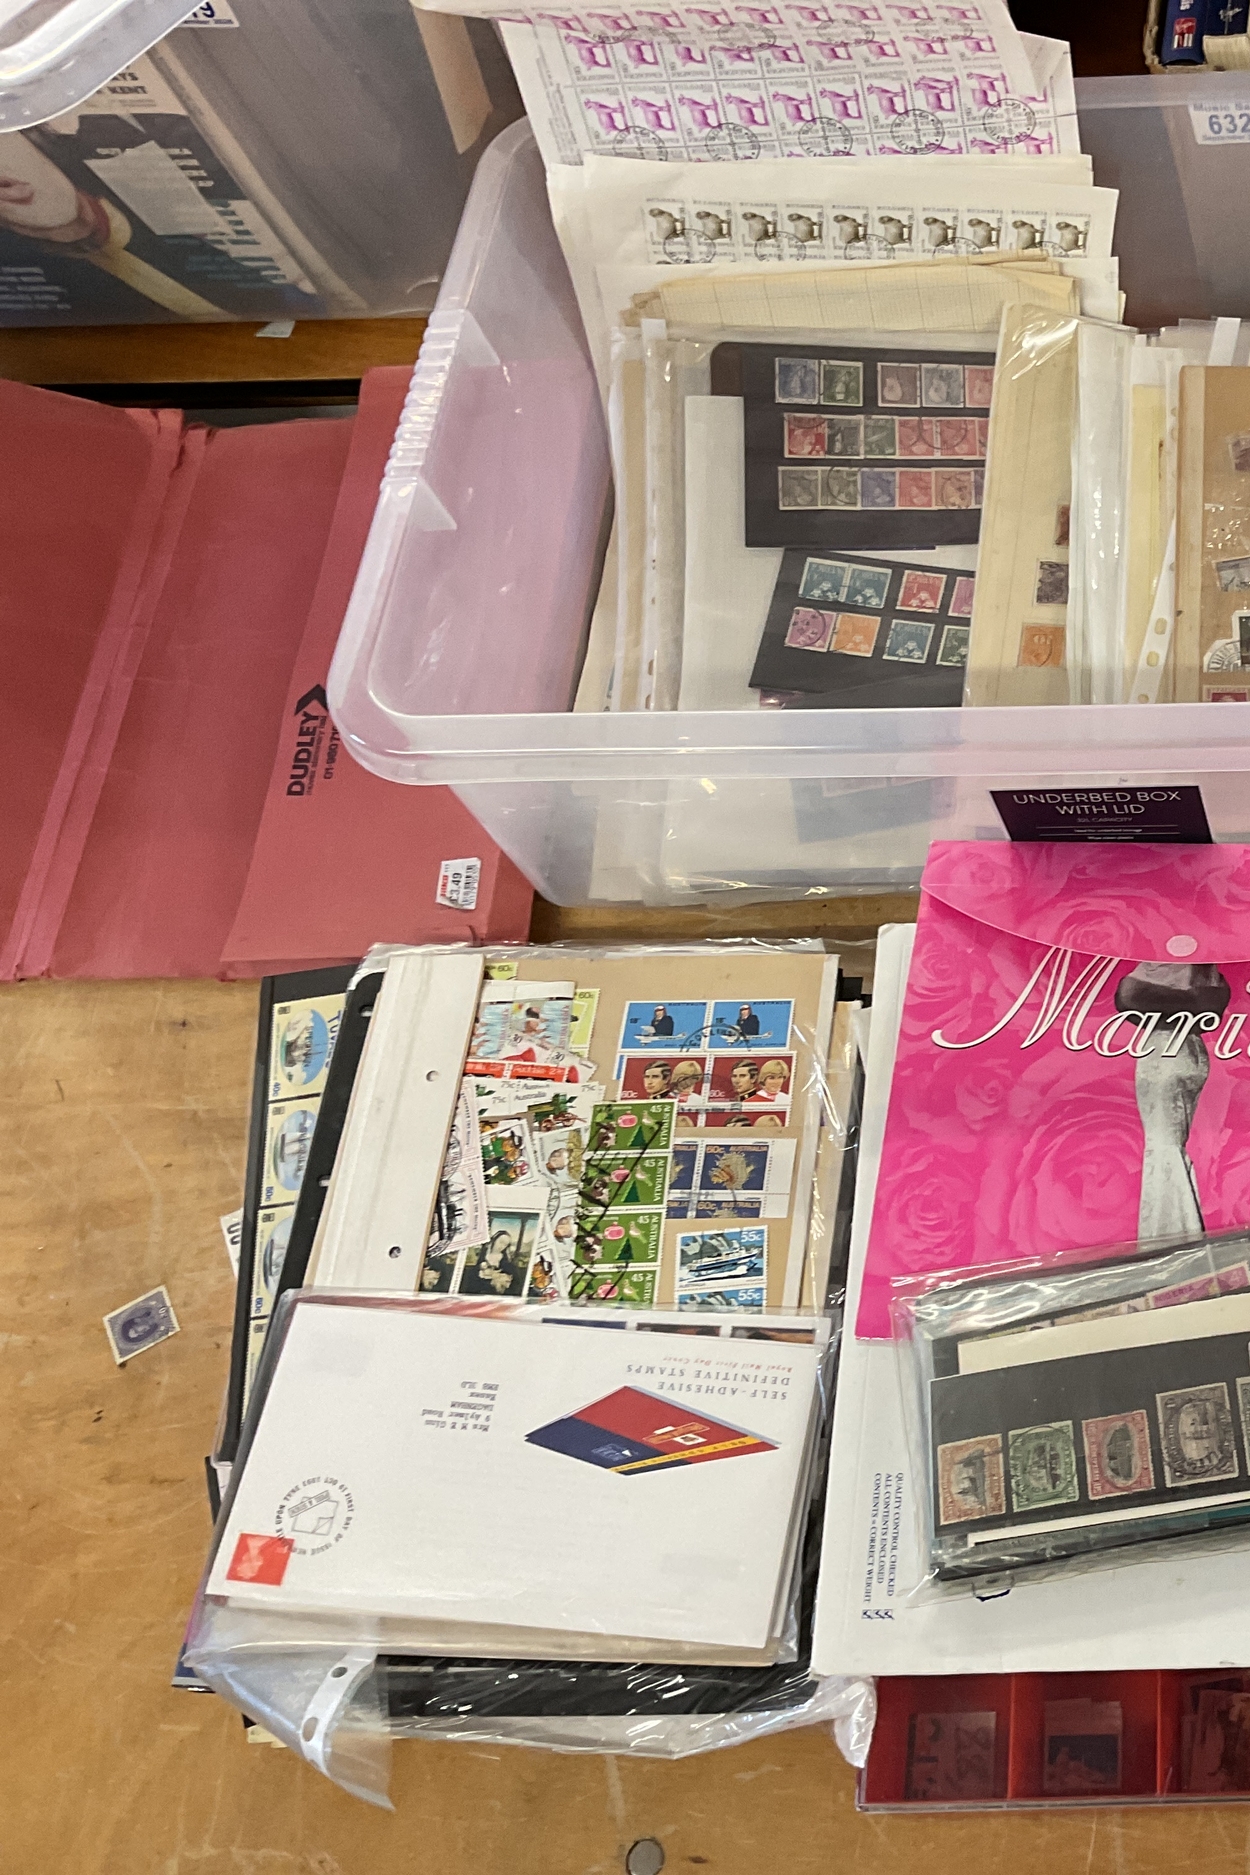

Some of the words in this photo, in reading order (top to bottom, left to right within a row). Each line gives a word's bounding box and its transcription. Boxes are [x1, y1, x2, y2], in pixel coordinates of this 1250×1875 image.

[286, 711, 320, 796] DUDLEY
[1012, 792, 1132, 805] UNDERBED
[1137, 791, 1182, 802] BOX
[1055, 804, 1108, 815] WITH
[1112, 804, 1146, 815] LID
[650, 1105, 663, 1114] 45
[643, 1158, 656, 1167] 45
[637, 1215, 650, 1224] 45
[740, 1231, 762, 1242] 55c
[738, 1289, 761, 1301] 55c
[625, 1364, 687, 1377] STAMPS
[693, 1369, 790, 1387] DEFINITIVE
[656, 1381, 788, 1401] SELF-ADHESIVE
[884, 1472, 893, 1490] ALL
[871, 1472, 882, 1518] CONTENTS
[894, 1472, 904, 1510] QUALITY
[880, 1491, 891, 1536] CONTENTS
[890, 1511, 901, 1553] CONTROL
[867, 1526, 877, 1567] CORRECT
[877, 1537, 888, 1584] ENCLOSED
[886, 1554, 898, 1597] CHECKED
[863, 1568, 873, 1604] WEIGHT
